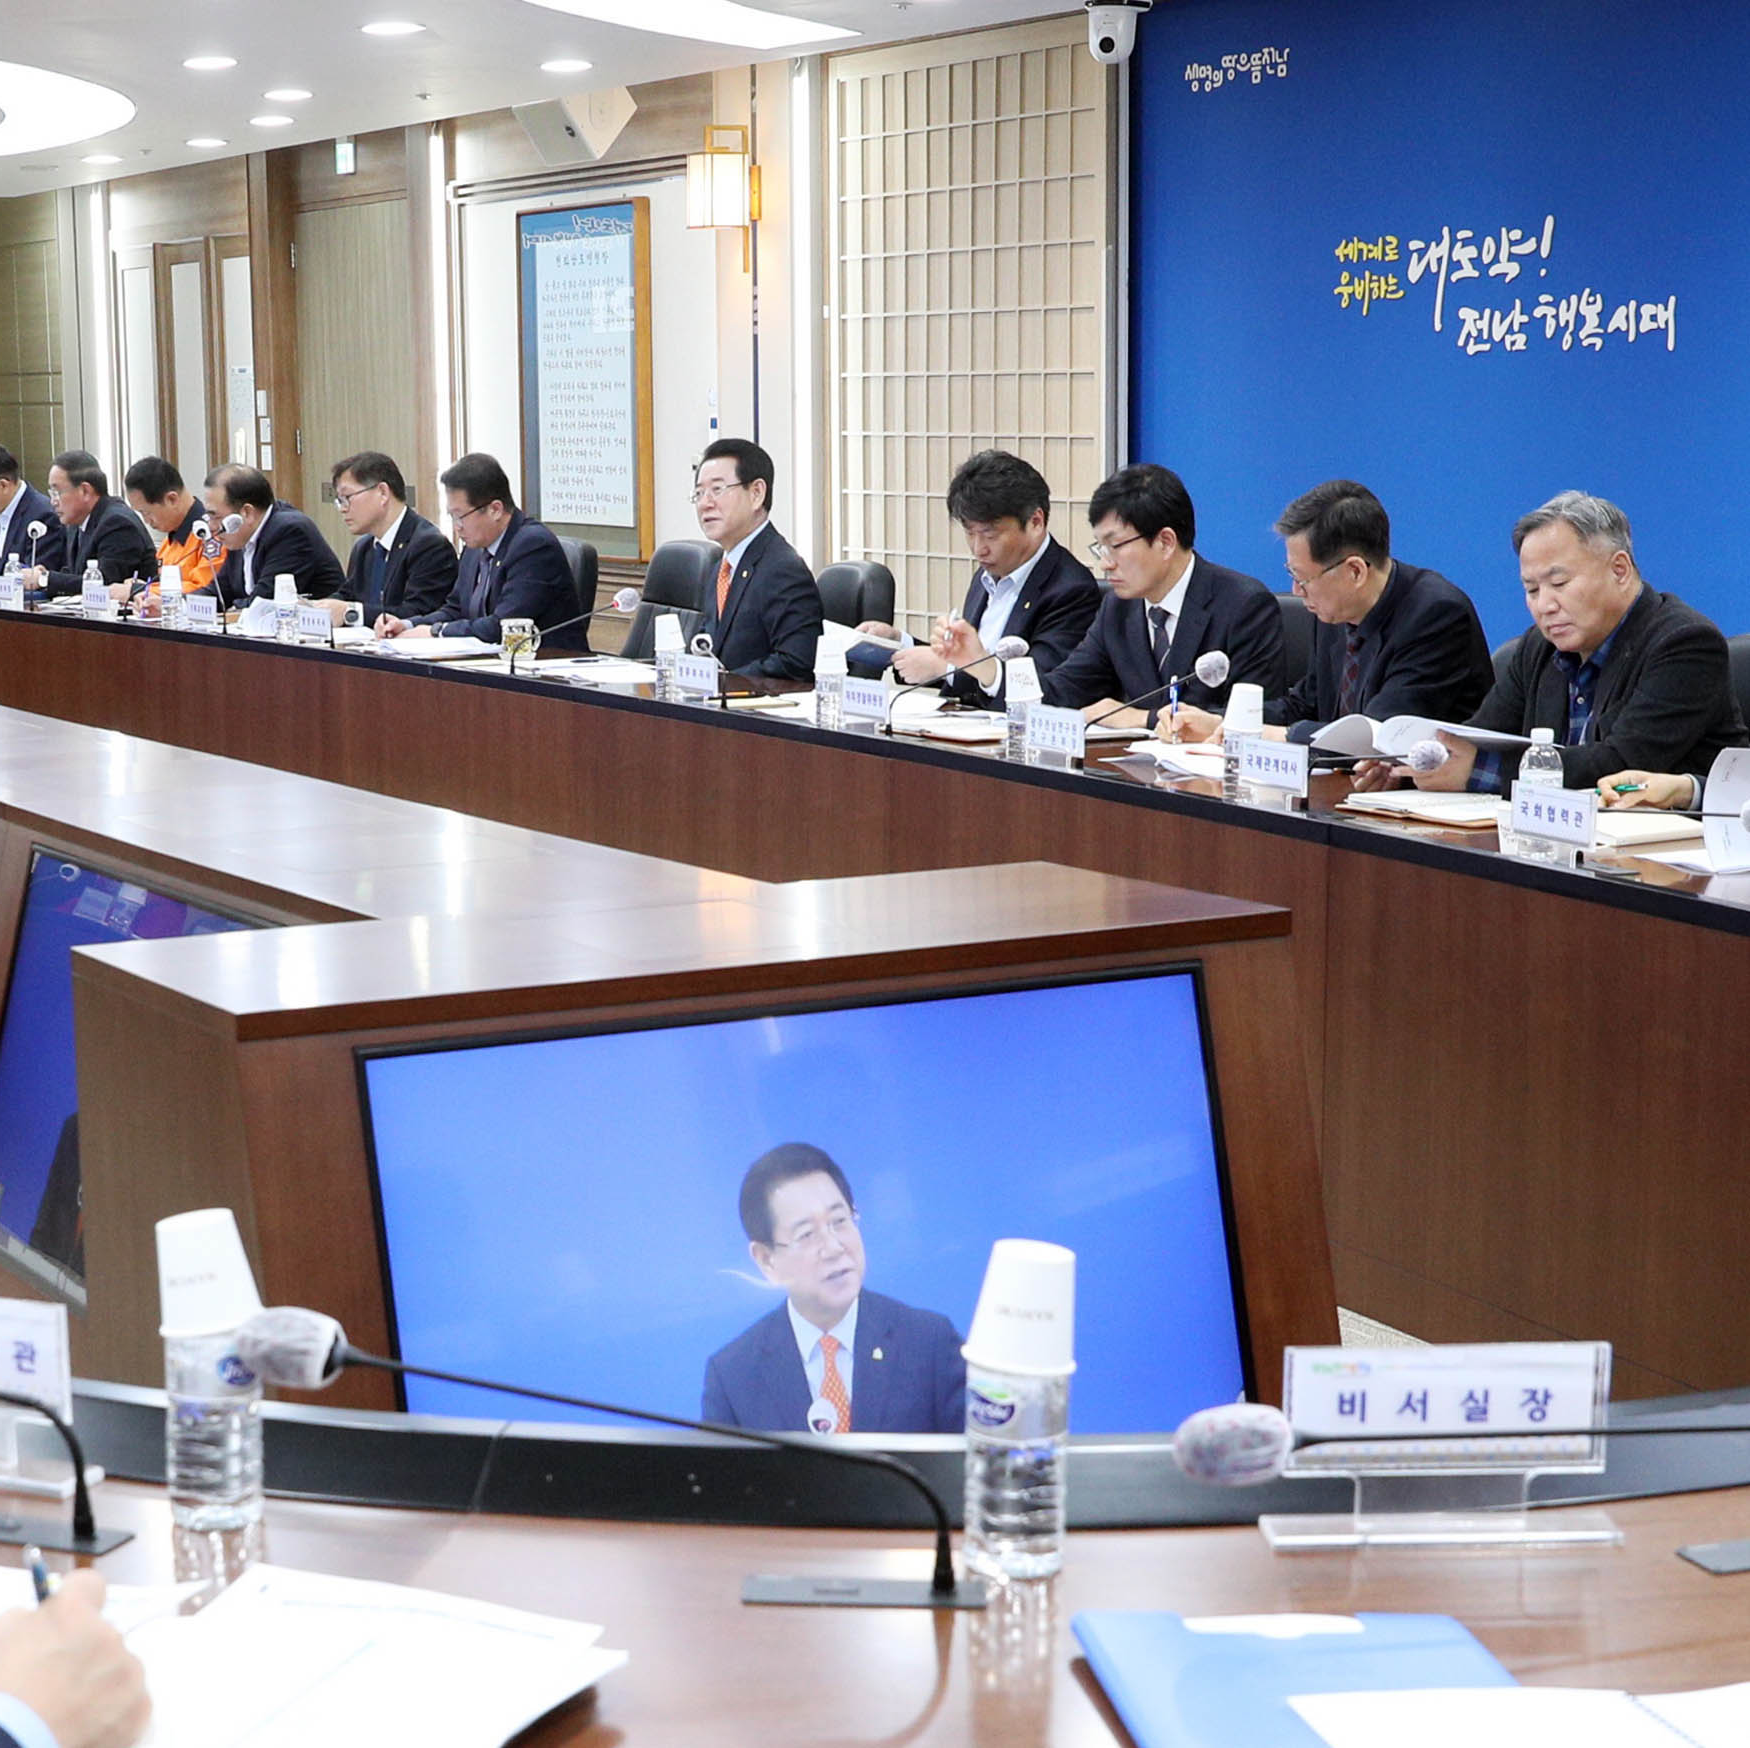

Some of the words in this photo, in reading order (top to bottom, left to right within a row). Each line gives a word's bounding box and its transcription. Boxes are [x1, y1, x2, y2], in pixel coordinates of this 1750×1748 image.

[1335, 236, 1399, 263] 세계로
[1334, 271, 1404, 316] 웅비하는
[1407, 216, 1555, 332] 대도약!
[1457, 299, 1530, 355] 전남
[1533, 287, 1677, 352] 행복시대
[1337, 1388, 1554, 1424] 비서실장
